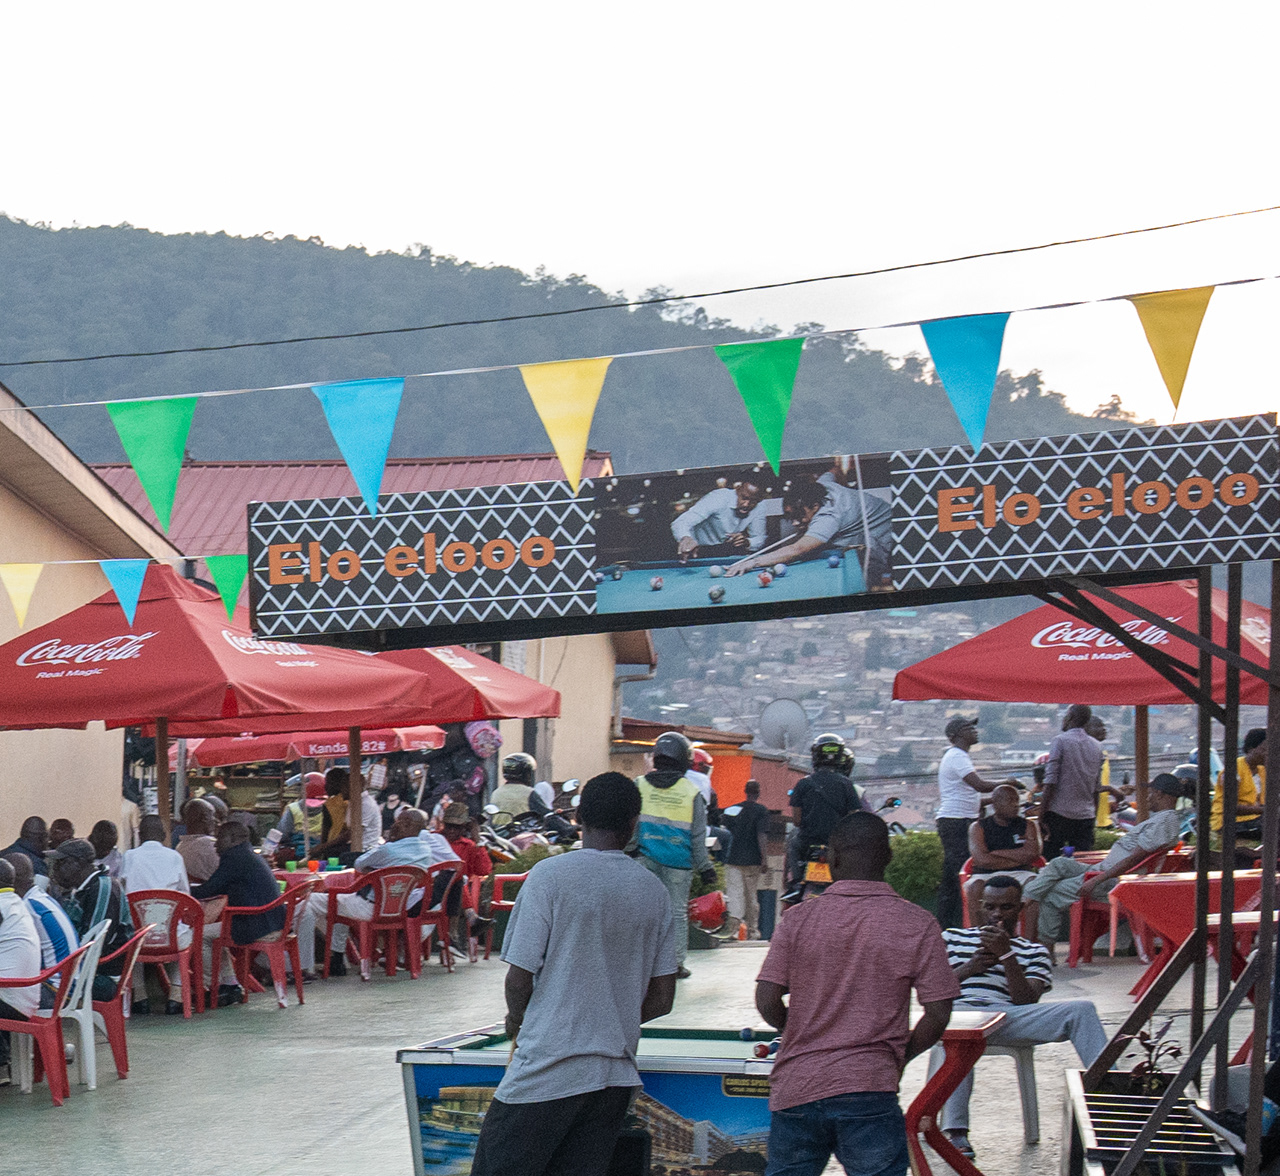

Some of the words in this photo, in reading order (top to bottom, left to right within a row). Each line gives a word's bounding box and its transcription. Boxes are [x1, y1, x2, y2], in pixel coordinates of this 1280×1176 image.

[937, 484, 1040, 533] Elo
[1066, 472, 1260, 520] elooo
[267, 541, 362, 586] Elo
[384, 533, 556, 578] elooo
[1058, 652, 1090, 662] Real
[1092, 651, 1134, 661] Magic
[36, 668, 65, 679] Real
[68, 668, 101, 677] Magic
[308, 742, 349, 755] Kanda
